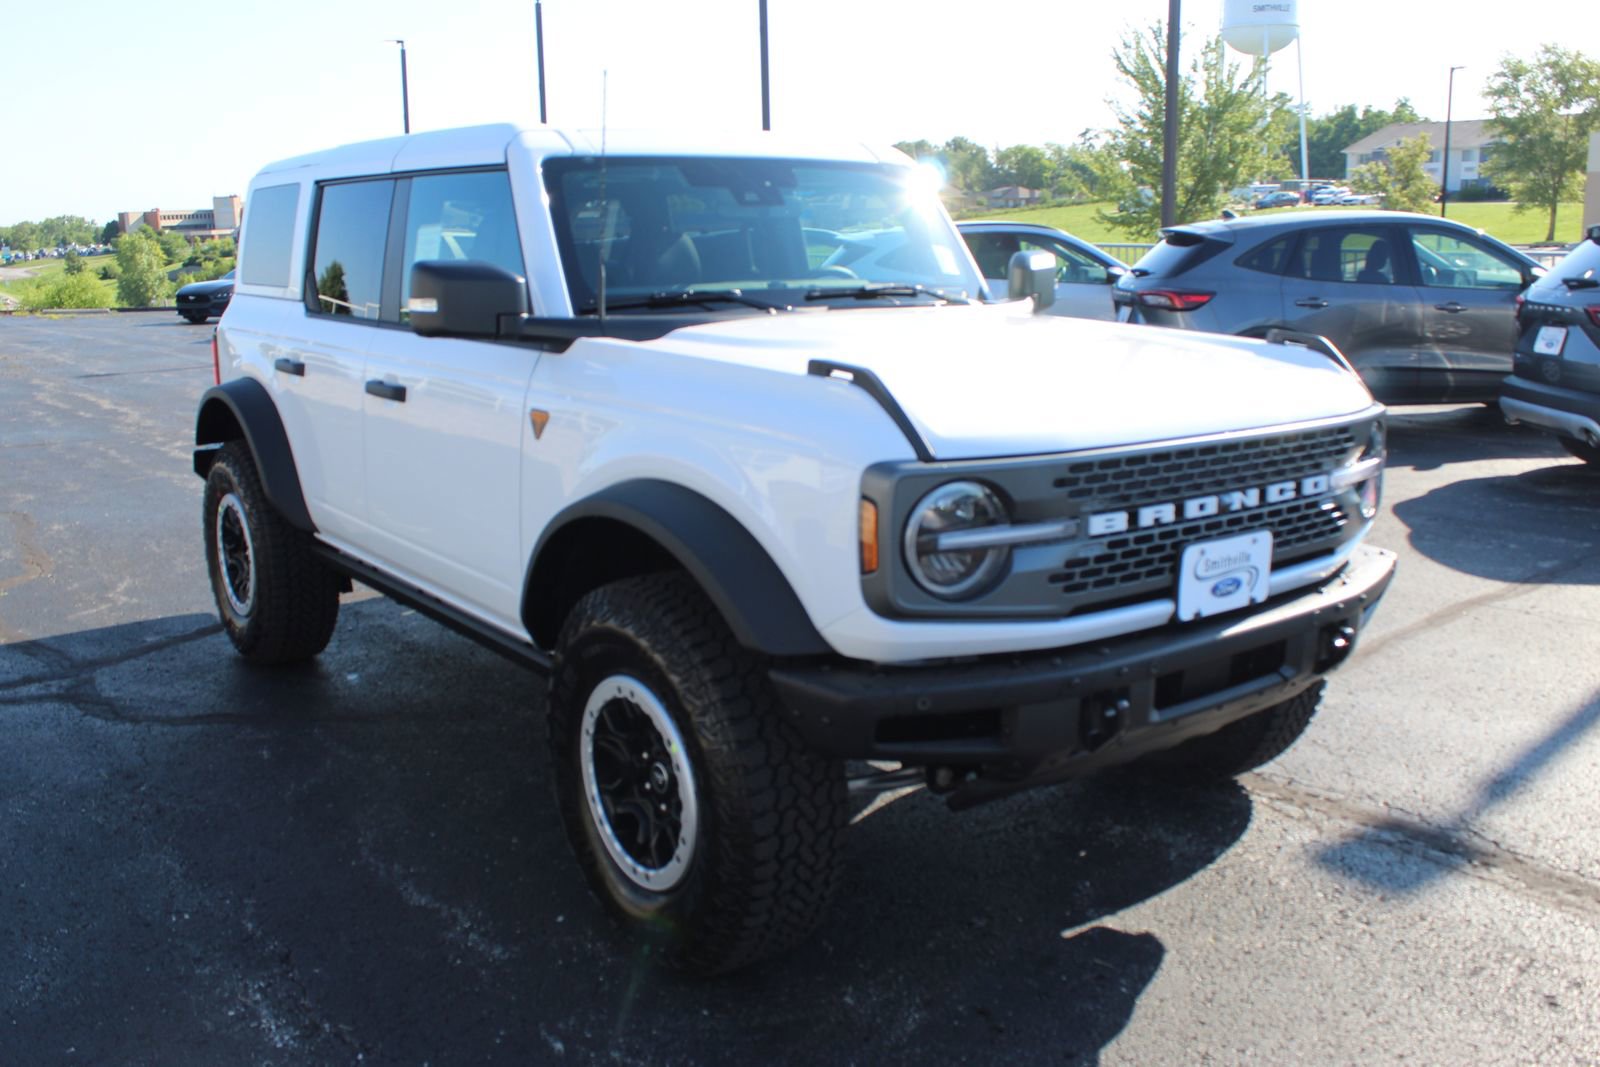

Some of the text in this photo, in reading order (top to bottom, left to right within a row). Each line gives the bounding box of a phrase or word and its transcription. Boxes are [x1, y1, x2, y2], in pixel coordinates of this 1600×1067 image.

[1088, 475, 1328, 536] BRONCO
[1204, 551, 1252, 573] Smithville
[1213, 578, 1241, 596] Ford
